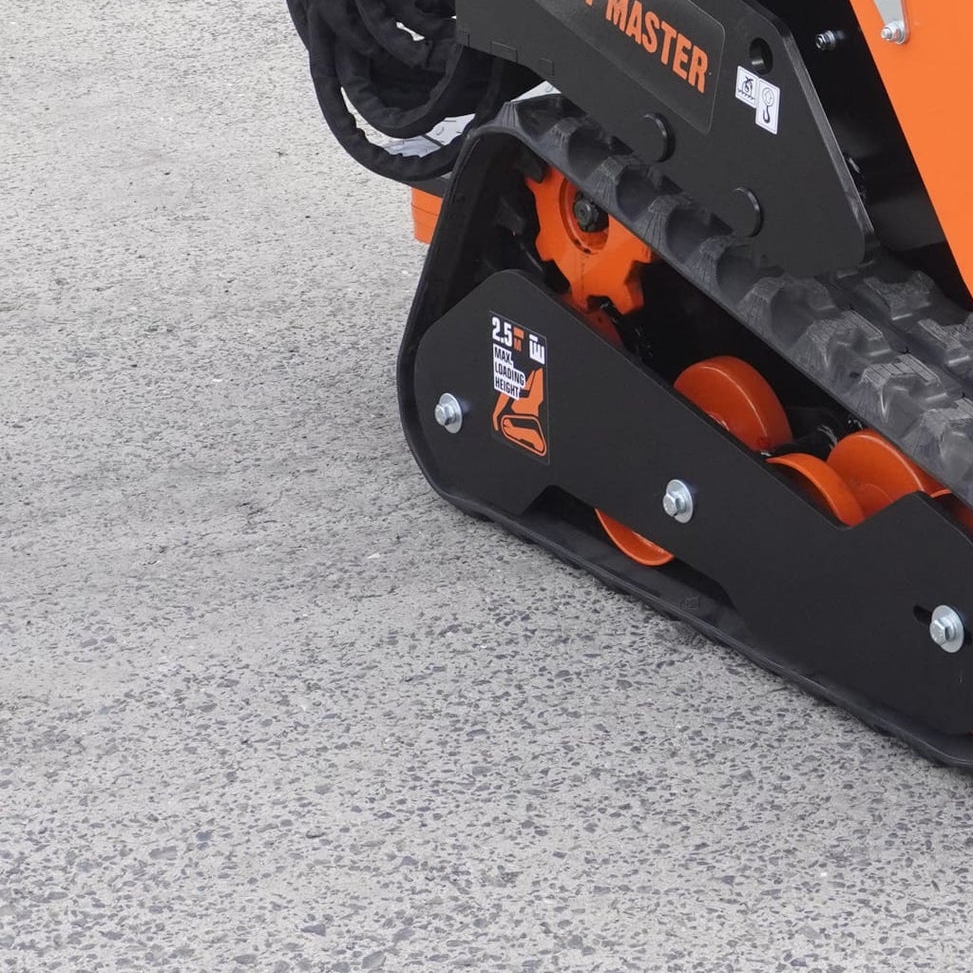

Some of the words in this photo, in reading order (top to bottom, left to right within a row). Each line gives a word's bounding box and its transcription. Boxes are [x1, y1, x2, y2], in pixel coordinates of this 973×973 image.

[492, 316, 513, 347] 2.5
[494, 362, 525, 387] LOADING
[495, 376, 519, 399] HEIGHT
